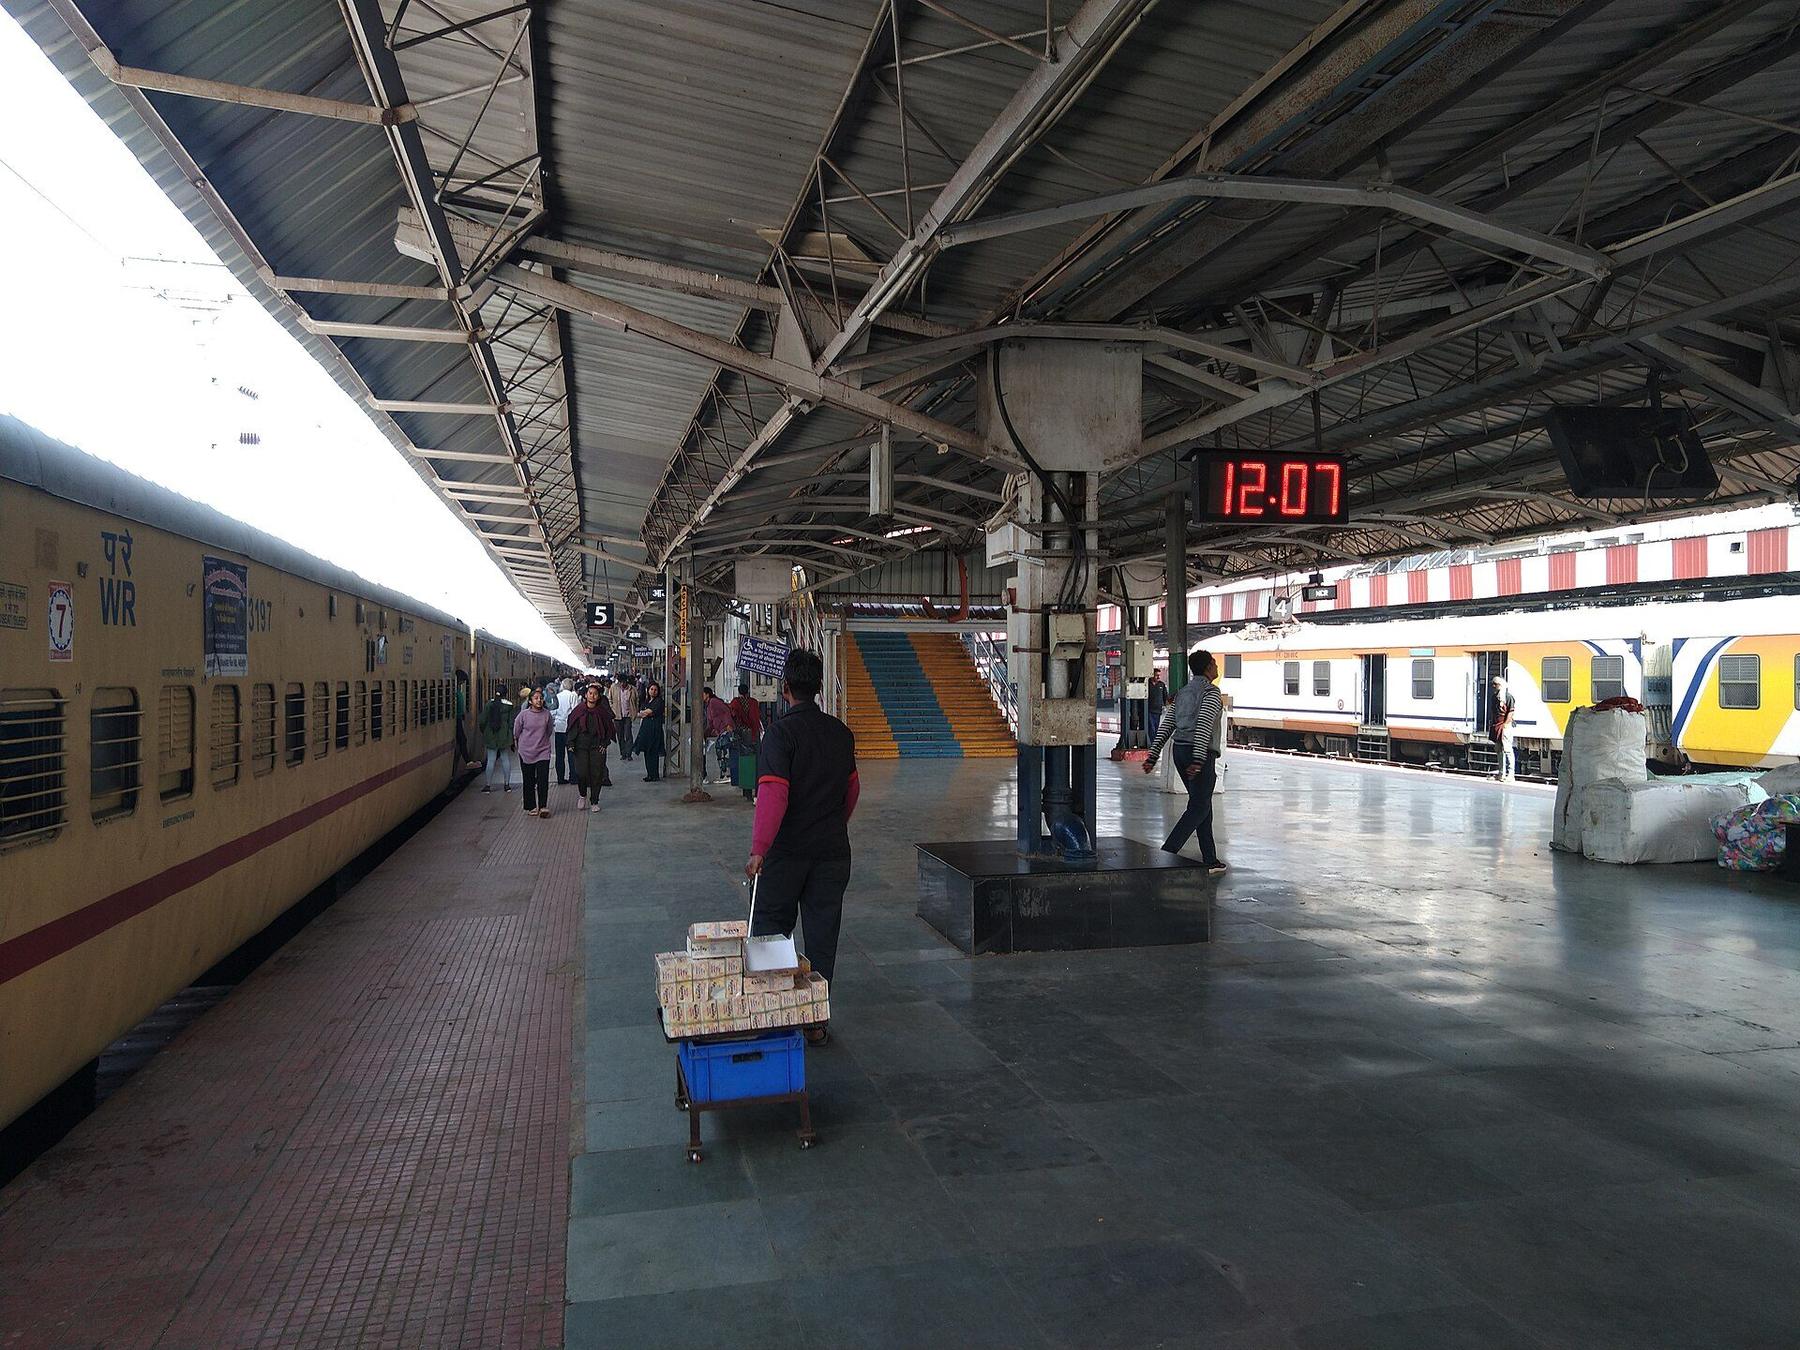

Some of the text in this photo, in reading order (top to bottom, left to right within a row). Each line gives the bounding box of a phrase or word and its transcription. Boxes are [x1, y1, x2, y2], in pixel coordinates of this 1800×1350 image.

[99, 576, 136, 626] WR
[1274, 599, 1287, 617] 4
[56, 604, 67, 638] 7
[594, 606, 608, 625] 5
